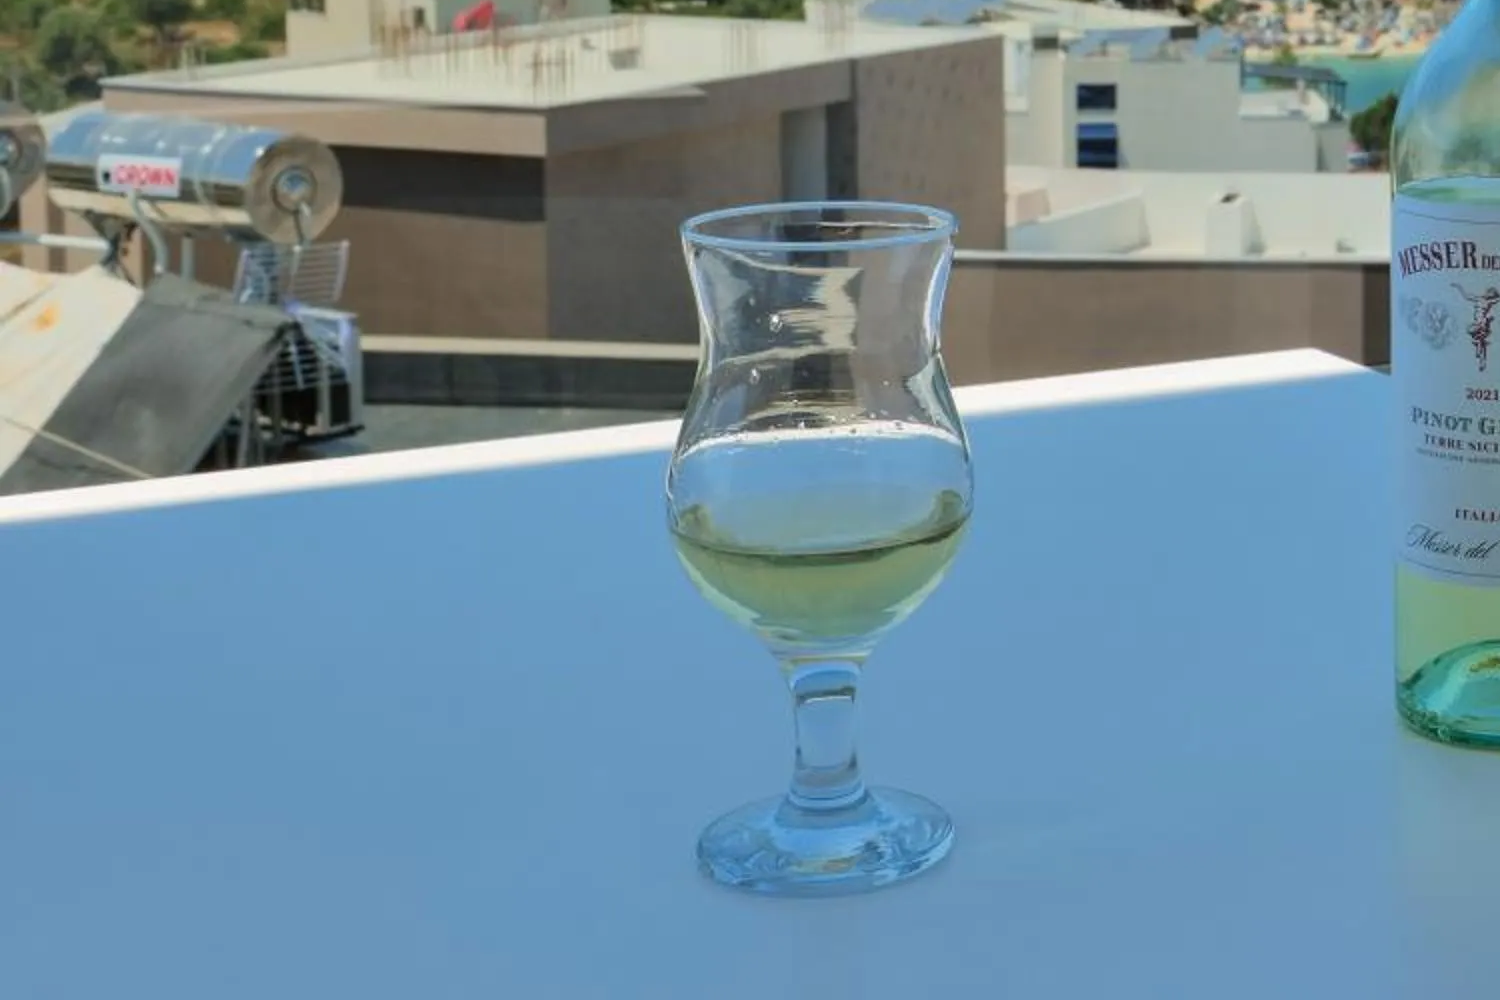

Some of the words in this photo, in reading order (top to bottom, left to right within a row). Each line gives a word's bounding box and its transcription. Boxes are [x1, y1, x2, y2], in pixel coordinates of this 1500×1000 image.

[115, 164, 177, 187] CROWN
[1398, 240, 1477, 279] MESSER
[1465, 387, 1499, 401] 2021
[1411, 406, 1472, 432] PINOT
[1424, 433, 1464, 450] TERRE
